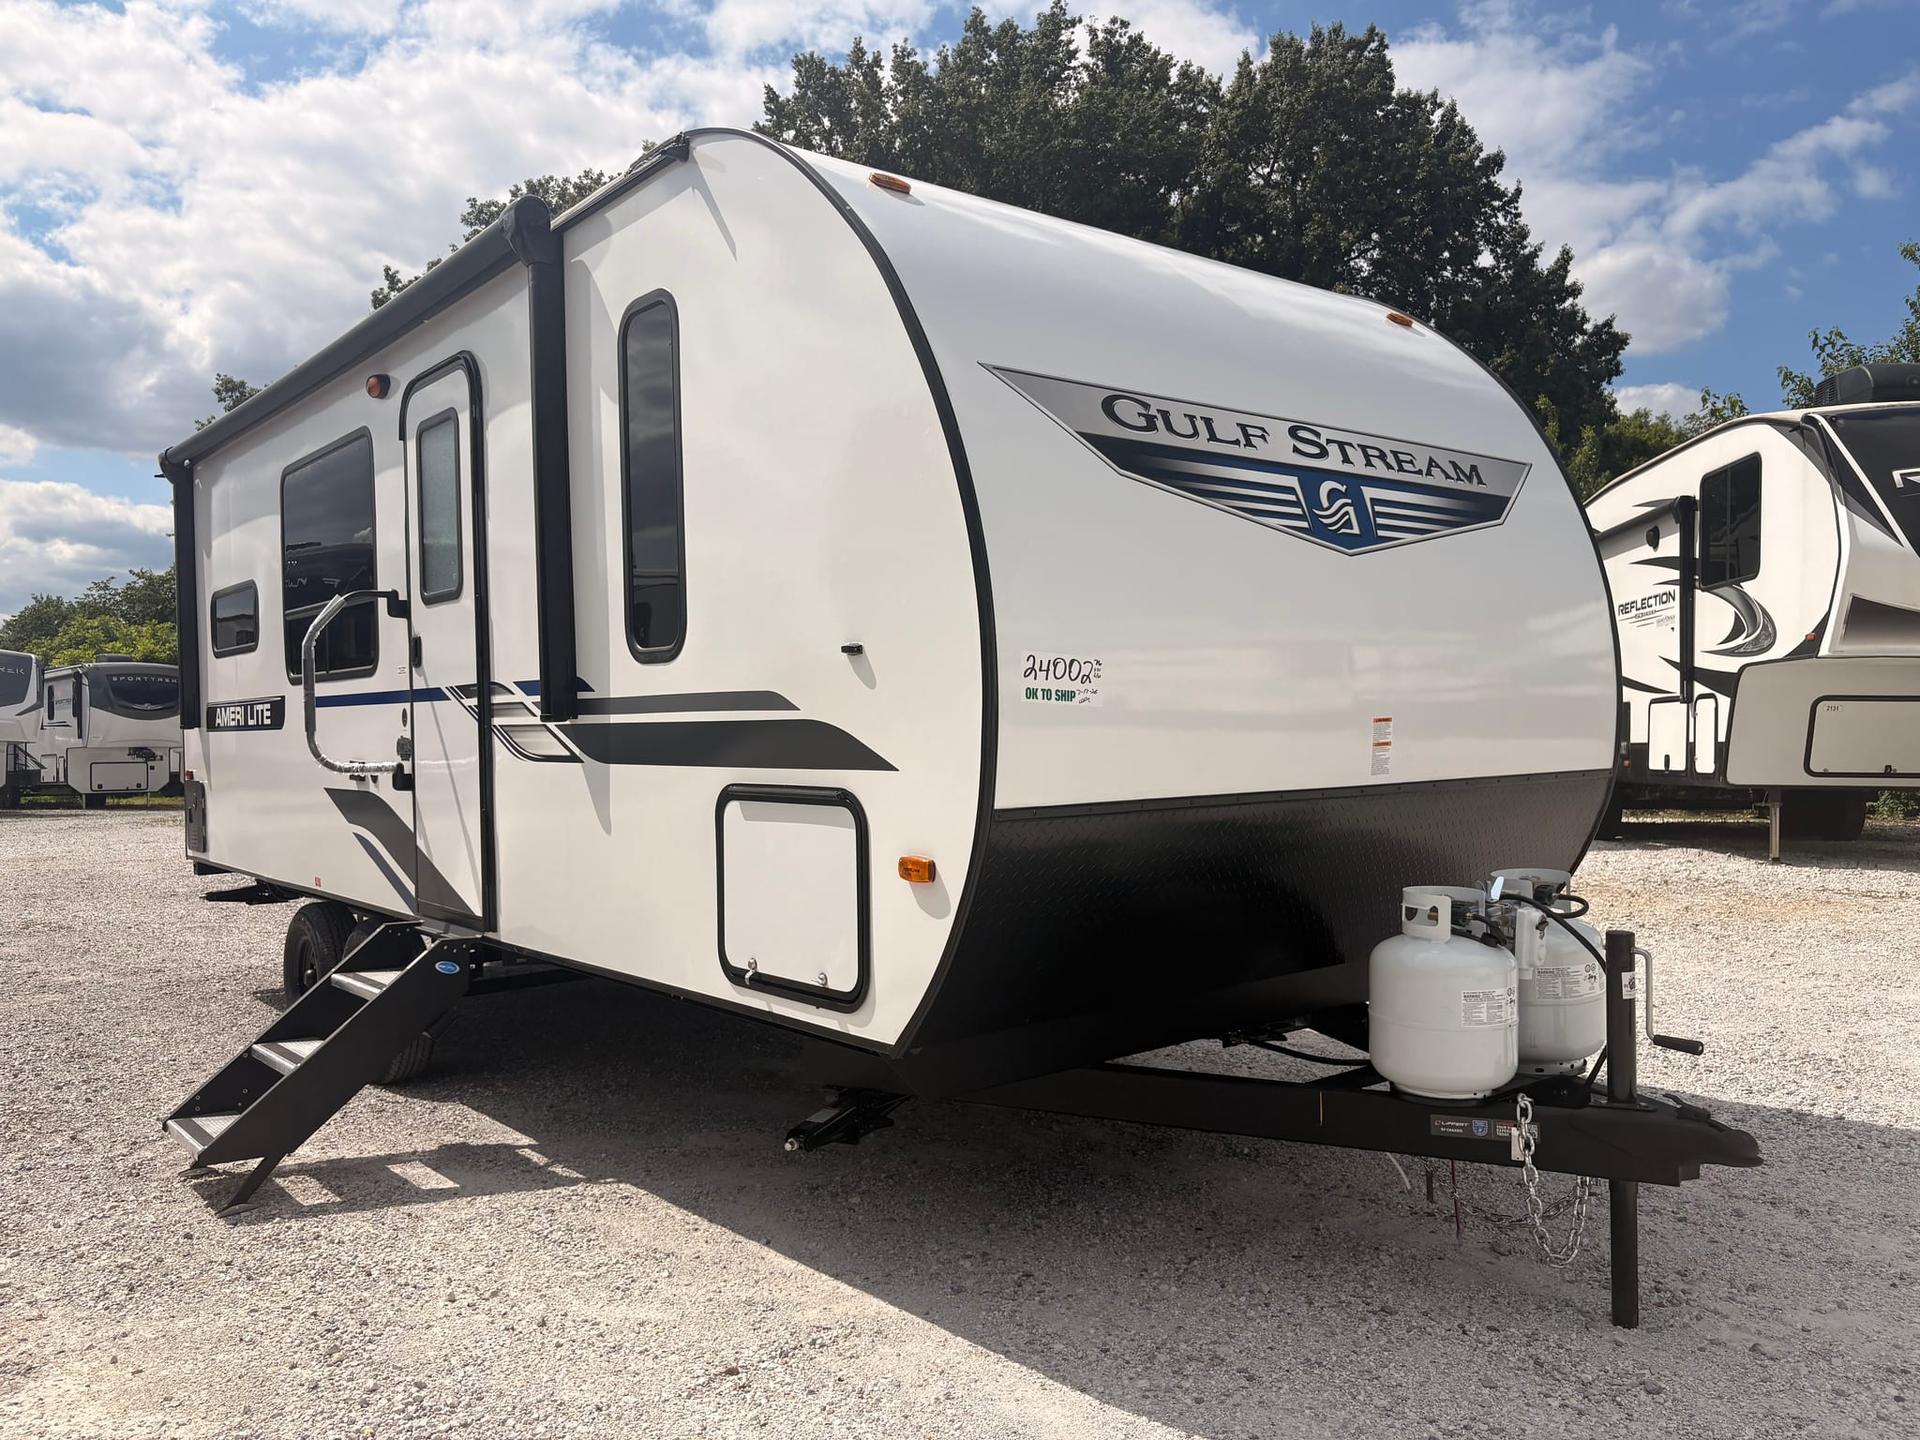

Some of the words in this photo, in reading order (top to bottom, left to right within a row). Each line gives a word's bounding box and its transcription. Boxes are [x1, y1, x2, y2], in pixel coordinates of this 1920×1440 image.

[1101, 393, 1270, 450] GULF
[1288, 424, 1488, 488] STREAM
[1617, 589, 1676, 616] REFLECTION
[1023, 654, 1094, 684] 24002
[1025, 687, 1039, 700] OK
[1041, 688, 1052, 701] TO
[1054, 689, 1076, 702] SHIP
[215, 705, 245, 727] AMERI
[247, 703, 271, 726] LITE
